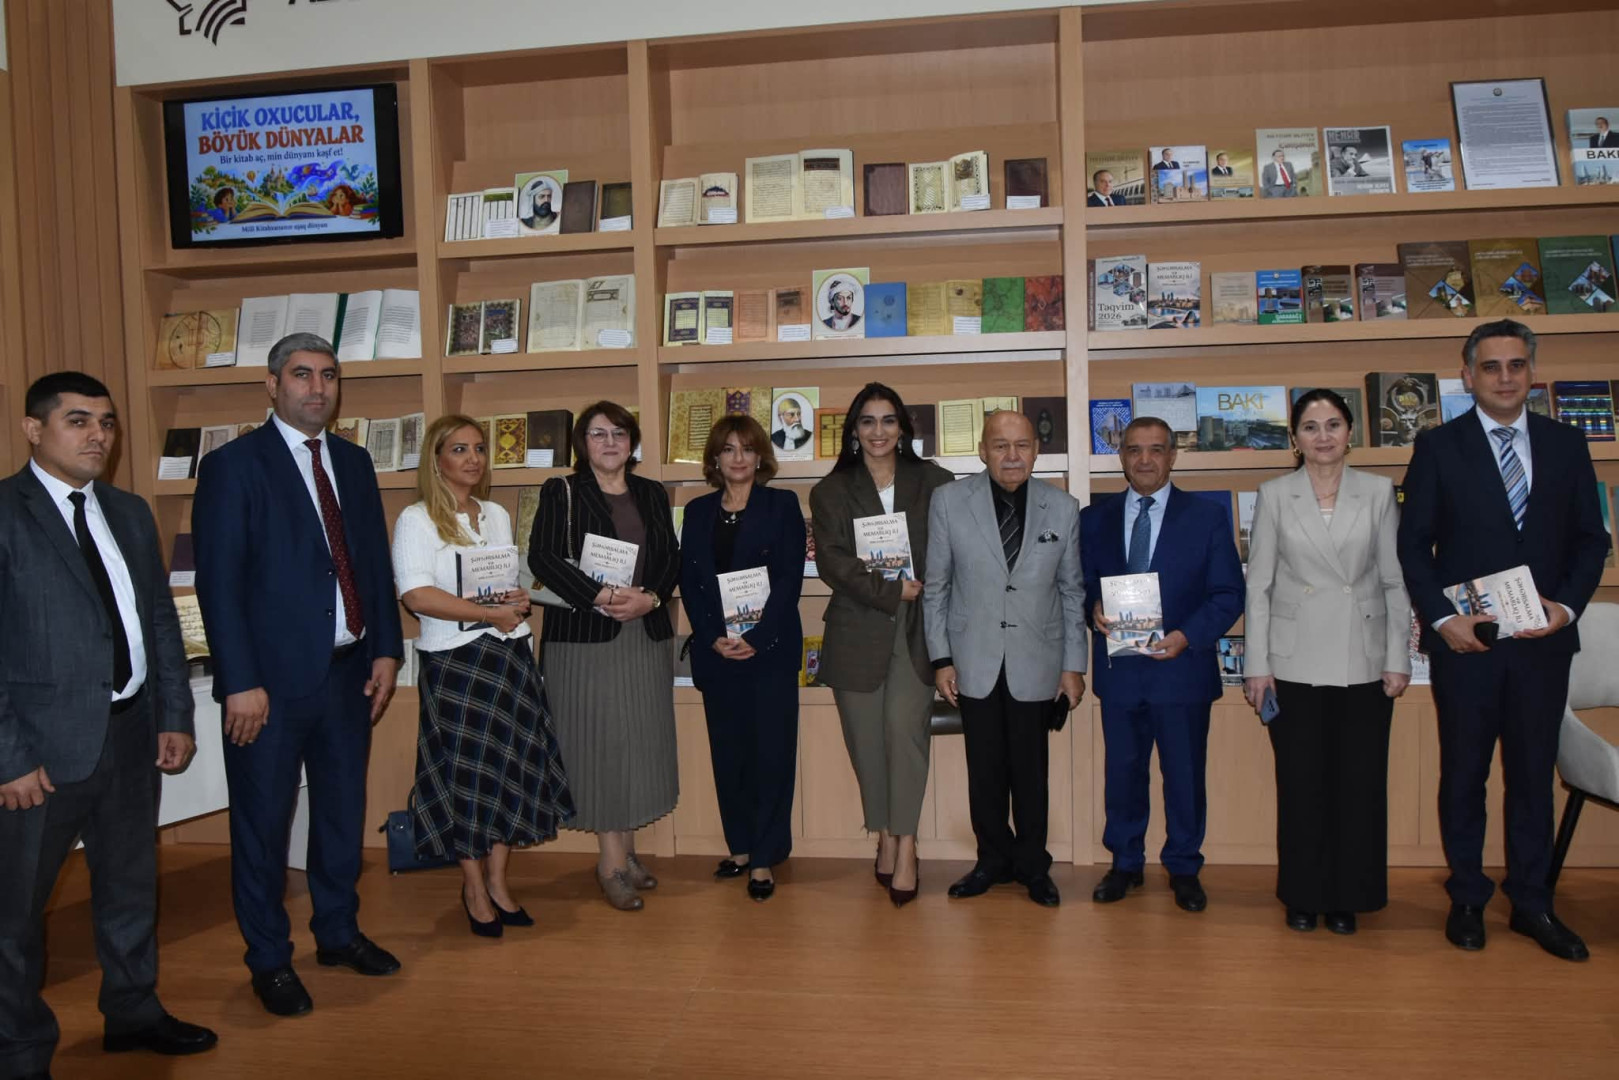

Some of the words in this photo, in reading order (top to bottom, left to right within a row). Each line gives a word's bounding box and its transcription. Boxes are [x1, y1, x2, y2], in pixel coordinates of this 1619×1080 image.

[202, 106, 250, 132] KİÇİK
[255, 101, 360, 126] OXUCULAR,
[198, 131, 260, 154] BÖYÜK
[266, 124, 364, 148] DÜNYALAR
[220, 155, 232, 164] Bir
[234, 154, 254, 163] kitab
[268, 152, 282, 162] min
[333, 148, 343, 156] et!
[1098, 312, 1122, 320] 2026
[1218, 392, 1263, 411] BAKI
